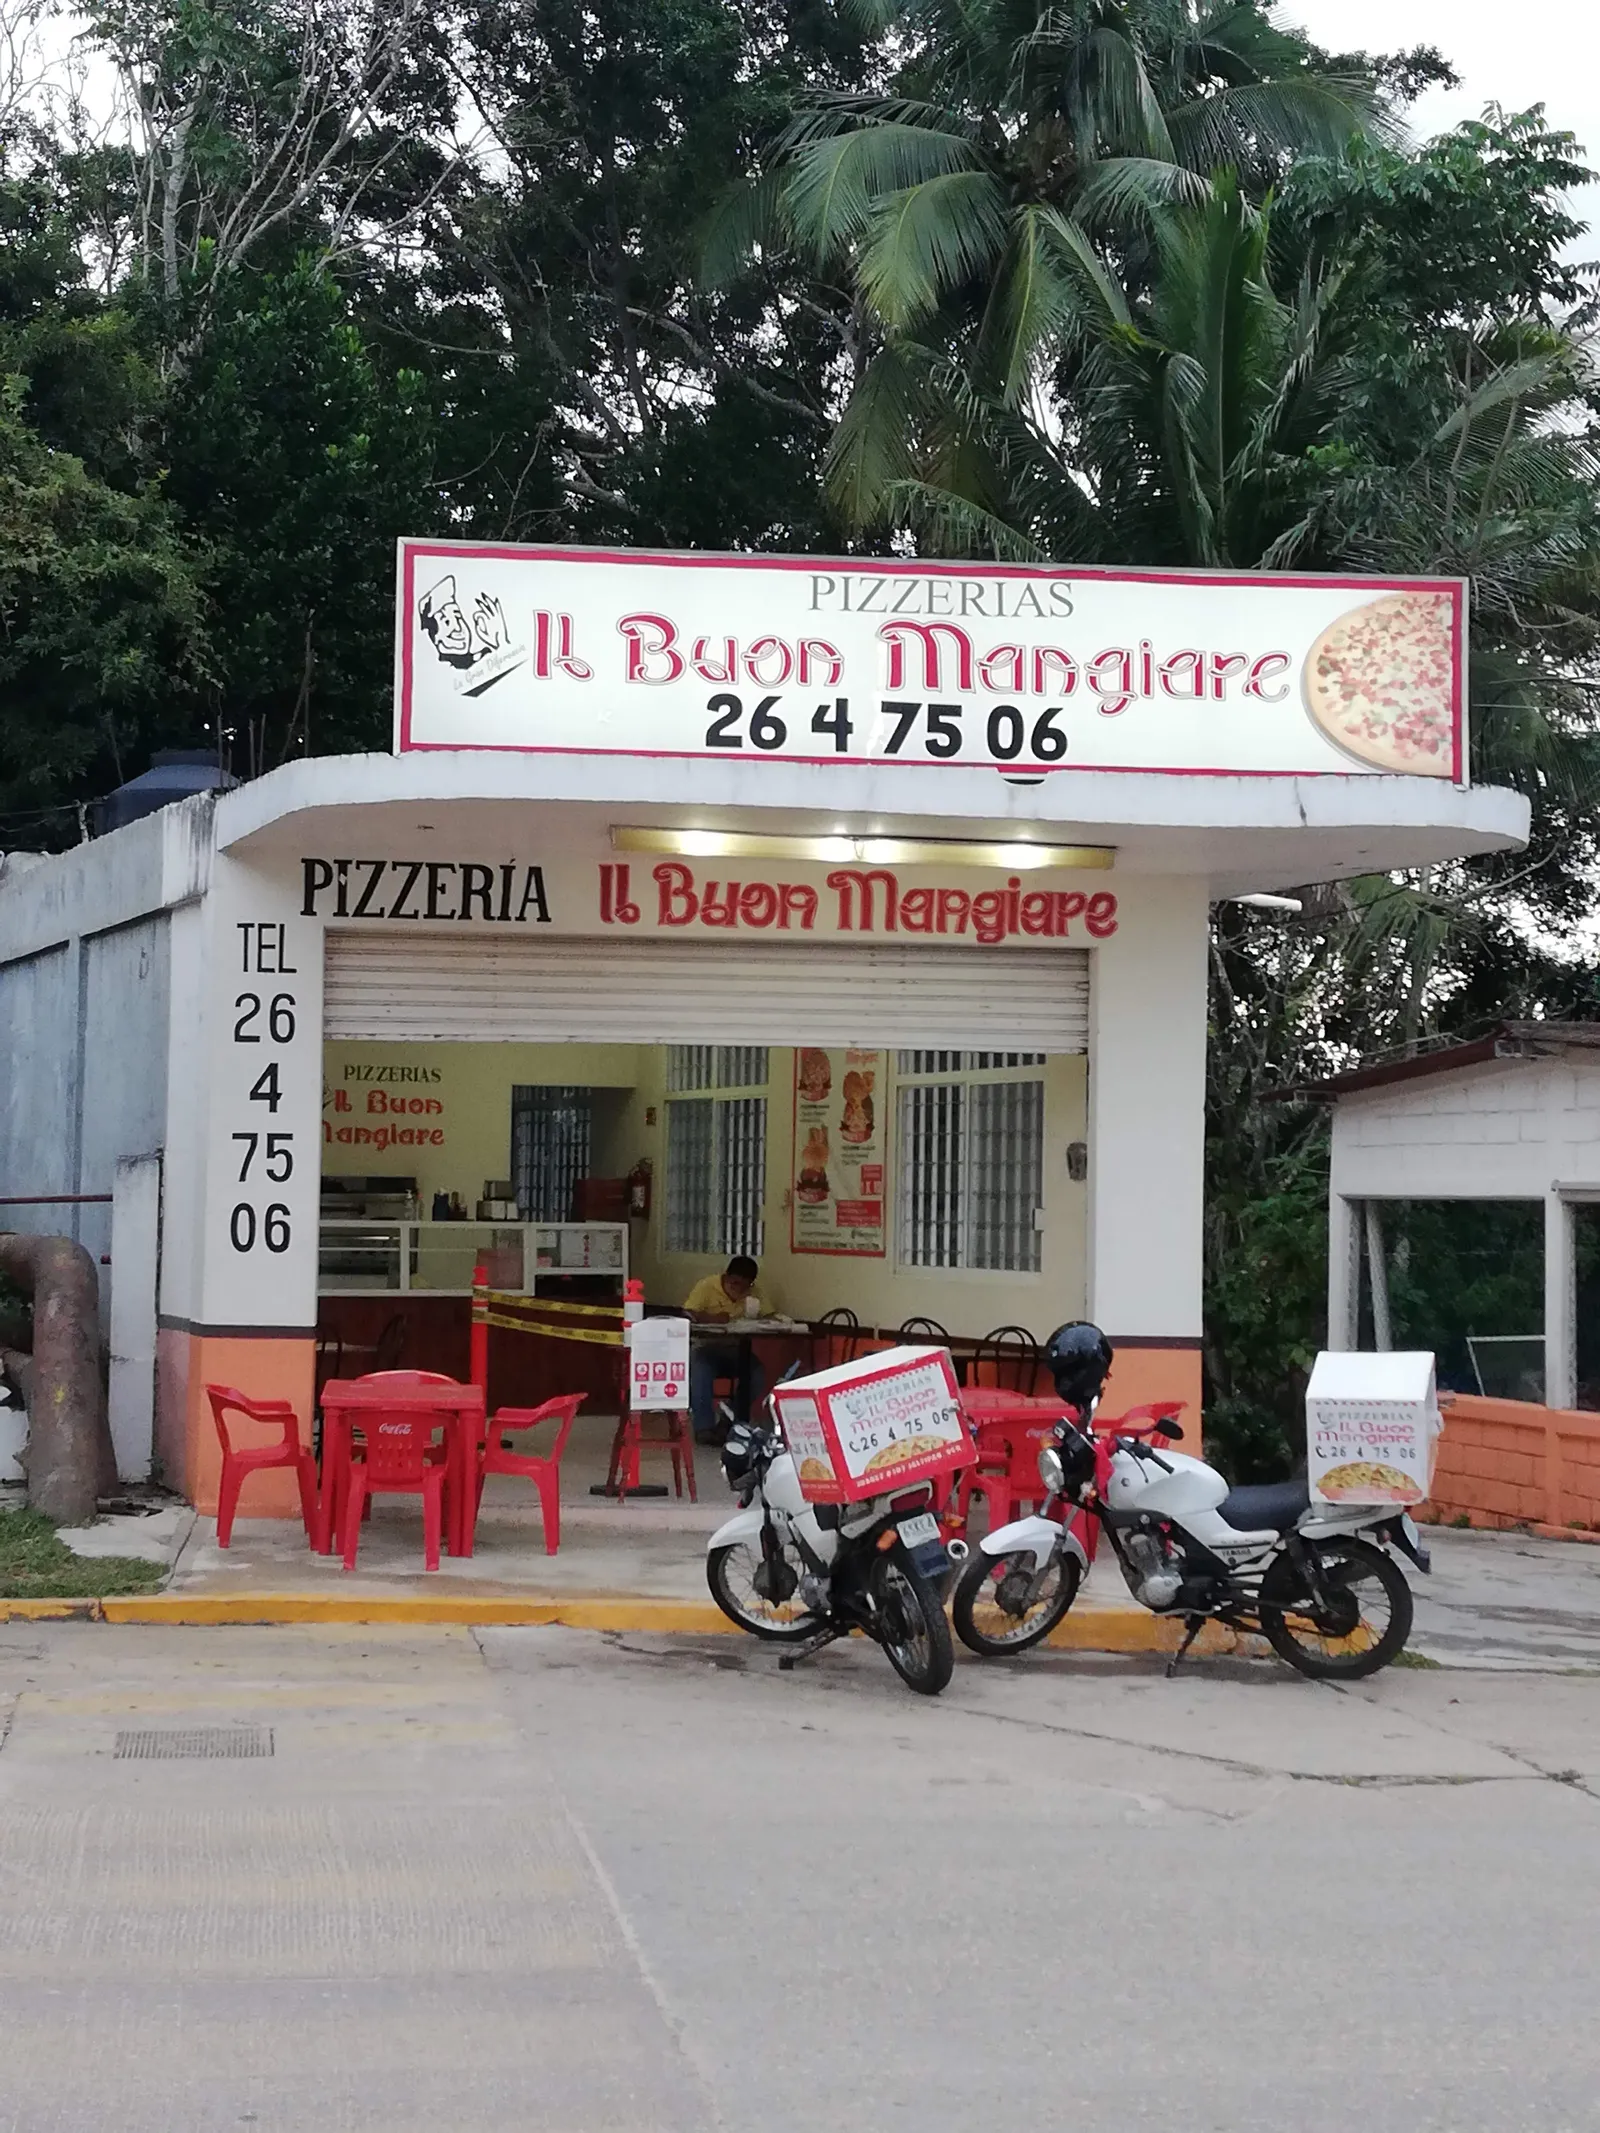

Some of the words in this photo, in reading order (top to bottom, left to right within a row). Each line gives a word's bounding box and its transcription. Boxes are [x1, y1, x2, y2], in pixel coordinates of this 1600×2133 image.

[808, 575, 1074, 618] PIZZERIAS
[616, 611, 845, 688] Buon
[876, 618, 1291, 718] Mangiare
[705, 693, 787, 751] 26
[811, 697, 854, 753] 4
[880, 700, 963, 759] 75
[986, 705, 1068, 761] 06
[300, 857, 552, 923] PIZZERÍA
[652, 861, 819, 930] Buon
[826, 869, 1118, 944] Mangiare
[237, 923, 297, 974] TEL
[234, 993, 296, 1044] 26
[249, 1062, 283, 1113] 4
[344, 1064, 442, 1084] PIZZERIAS
[367, 1089, 443, 1114] Buon
[232, 1132, 294, 1183] 75
[230, 1202, 291, 1254] 06
[850, 1396, 939, 1434] Mangiare
[886, 1387, 936, 1411] Buon
[1338, 1412, 1413, 1421] PIZZERIAS
[860, 1433, 878, 1452] 26
[888, 1426, 897, 1441] 4
[904, 1417, 923, 1435] 75
[932, 1407, 950, 1425] 06
[1315, 1430, 1416, 1445] Mangiare
[1360, 1421, 1415, 1433] Buon
[1331, 1447, 1347, 1458] 26
[1374, 1447, 1390, 1459] 75
[1400, 1447, 1416, 1459] 06
